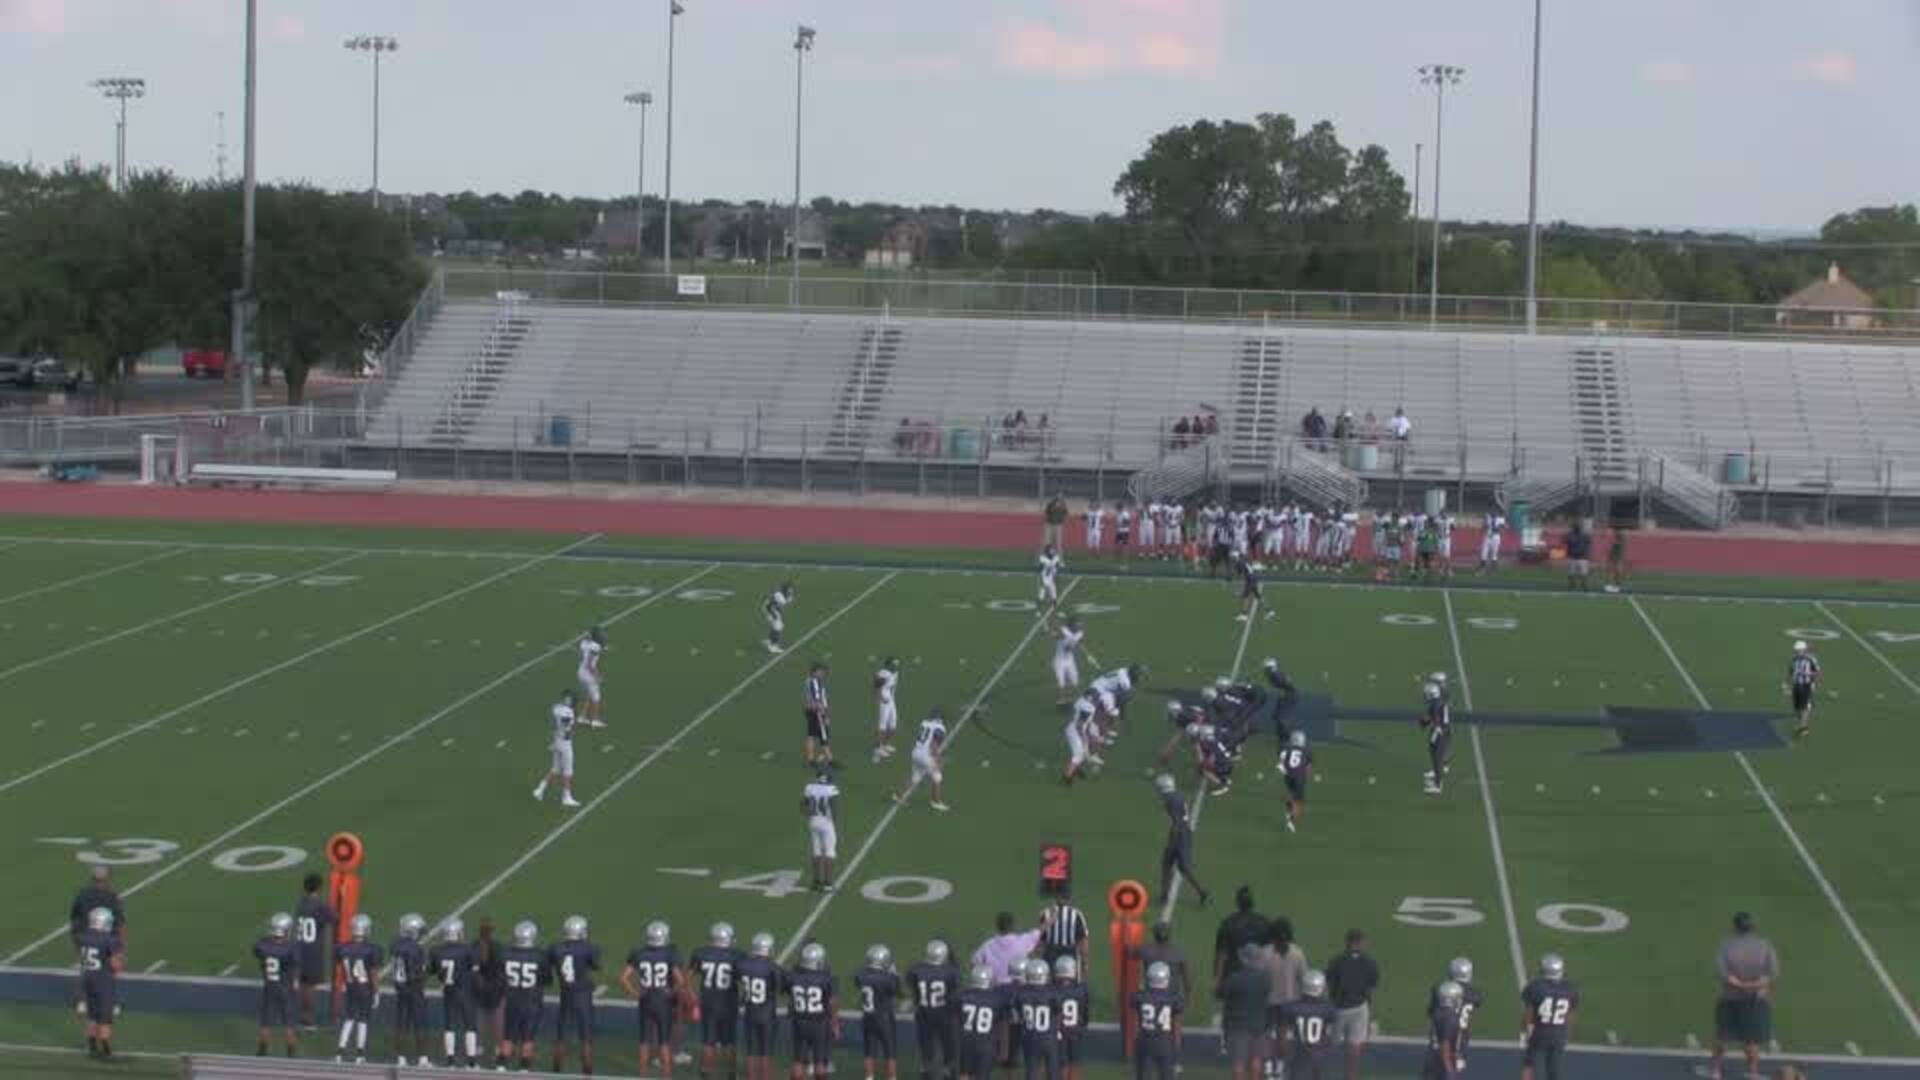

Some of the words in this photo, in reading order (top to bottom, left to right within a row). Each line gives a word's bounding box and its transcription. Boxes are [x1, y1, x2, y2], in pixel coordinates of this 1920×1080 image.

[1042, 847, 1066, 880] 2
[440, 959, 455, 985] 7
[505, 960, 538, 988] 55
[561, 954, 575, 982] 4
[638, 961, 667, 988] 32
[701, 961, 732, 989] 76
[792, 985, 822, 1013] 62
[917, 981, 944, 1008] 12
[961, 1003, 993, 1033] 78
[1062, 999, 1077, 1027] 9
[1141, 1003, 1170, 1032] 24
[1538, 997, 1569, 1025] 42
[1295, 1016, 1322, 1044] 10
